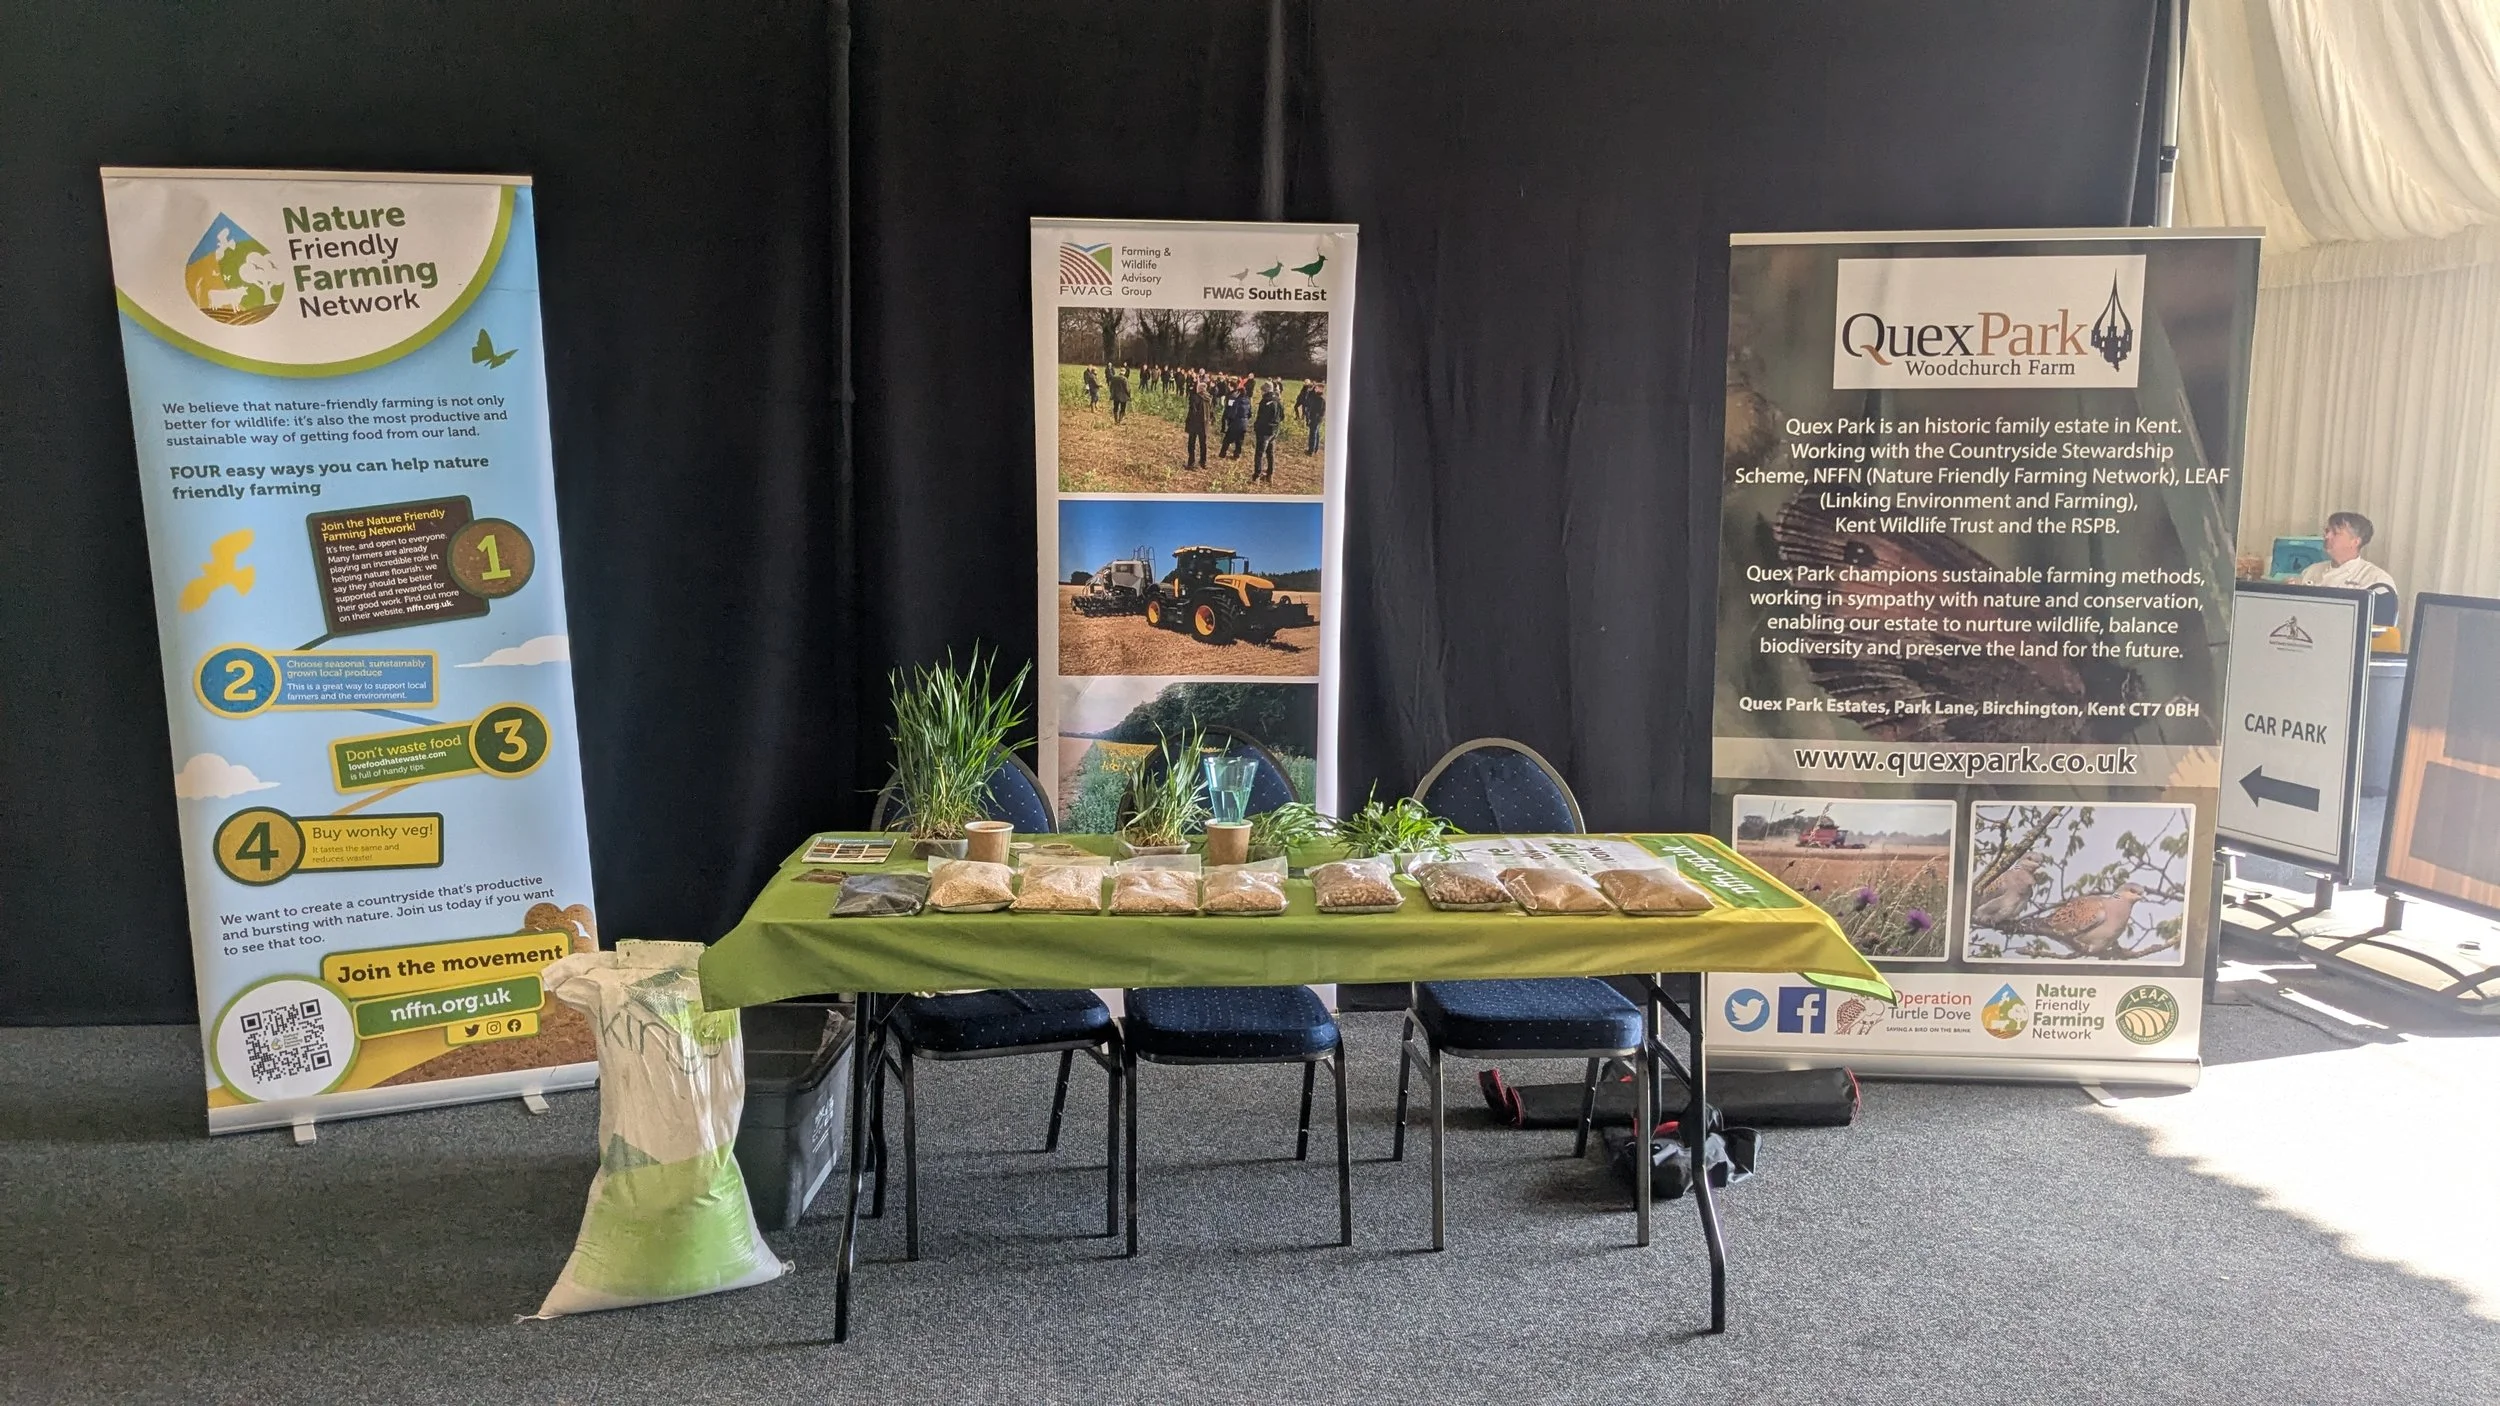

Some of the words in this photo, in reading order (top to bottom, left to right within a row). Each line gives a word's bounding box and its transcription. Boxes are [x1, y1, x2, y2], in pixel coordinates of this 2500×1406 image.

[283, 206, 406, 234] Nature
[289, 233, 398, 260] Friendly
[1122, 246, 1160, 258] Farming
[1164, 248, 1171, 256] &
[1121, 260, 1156, 269] Wildlife
[294, 260, 438, 292] Farming
[1122, 273, 1162, 285] Advisory
[1060, 286, 1112, 296] FWAG
[1122, 286, 1152, 298] Group
[1204, 287, 1244, 299] FWAG
[300, 288, 420, 318] Network
[1905, 359, 2021, 376] Woodchurch
[2028, 360, 2075, 375] Farm
[162, 403, 184, 414] We
[188, 402, 239, 413] believe
[243, 401, 271, 411] that
[274, 398, 378, 411] nature-friendly
[382, 397, 434, 409] farming
[438, 397, 448, 406] is
[451, 397, 473, 406] not
[477, 395, 504, 407] only
[1786, 418, 1833, 436] Quex
[1838, 418, 1875, 434] Park
[1880, 418, 1892, 434] is
[1898, 422, 1919, 434] an
[1926, 417, 1990, 433] historic
[1995, 417, 2050, 437] family
[2055, 419, 2109, 433] estate
[2115, 418, 2130, 433] in
[2136, 417, 2181, 433] Kent.
[1791, 442, 1865, 462] Working
[1870, 442, 1909, 458] with
[1915, 442, 1944, 458] the
[1949, 442, 2057, 462] Countryside
[2062, 442, 2173, 462] Stewardship
[170, 465, 221, 479] FOUR
[226, 466, 265, 479] easy
[270, 465, 314, 477] ways
[318, 463, 352, 476] you
[356, 462, 388, 472] can
[391, 458, 429, 472] help
[434, 457, 488, 469] nature
[1735, 467, 1808, 486] Scheme,
[1814, 468, 1861, 483] NFFN
[1867, 468, 1933, 486] (Nature
[1939, 467, 2010, 488] Friendly
[2015, 468, 2086, 487] Farming
[2093, 467, 2179, 486] Network),
[2186, 468, 2230, 484] LEAF
[172, 484, 245, 500] friendly
[250, 482, 320, 496] farming
[1820, 492, 1891, 512] (Linking
[1897, 492, 2011, 508] Environment
[2016, 492, 2049, 508] and
[2055, 493, 2137, 512] Farming),
[321, 522, 344, 531] Join
[346, 520, 364, 528] the
[366, 516, 402, 526] Nature
[404, 509, 445, 524] Friendly
[1836, 517, 1876, 532] Kent
[1880, 516, 1946, 533] Wildlife
[1950, 518, 1994, 533] Trust
[1999, 517, 2032, 533] and
[2037, 517, 2066, 533] the
[2072, 518, 2119, 533] RSPB.
[322, 530, 366, 542] Farming
[369, 522, 416, 536] Network!
[476, 535, 511, 580] 1
[1747, 566, 1793, 585] Quex
[1796, 566, 1835, 581] Park
[1839, 566, 1937, 586] champions
[1942, 566, 2042, 582] sustainable
[2047, 566, 2116, 587] farming
[2122, 568, 2204, 586] methods,
[1750, 590, 1821, 609] working
[1828, 591, 1842, 605] in
[1848, 591, 1934, 610] sympathy
[1940, 591, 1977, 606] with
[1984, 594, 2040, 607] nature
[2046, 592, 2078, 607] and
[2084, 594, 2202, 611] conservation,
[1768, 614, 1847, 634] enabling
[1850, 619, 1880, 630] our
[1884, 617, 1938, 631] estate
[1943, 618, 1960, 631] to
[1966, 618, 2032, 632] nurture
[2037, 616, 2103, 634] wildlife,
[2110, 617, 2178, 633] balance
[1760, 637, 1863, 660] biodiversity
[1866, 638, 1902, 658] and
[1906, 640, 1981, 659] preserve
[1986, 640, 2015, 656] the
[2020, 640, 2058, 656] land
[2063, 641, 2087, 656] for
[2092, 641, 2120, 657] the
[2125, 641, 2183, 658] future.
[224, 660, 256, 700] 2
[1740, 697, 1782, 711] Quex
[1786, 698, 1823, 712] Park
[1827, 696, 1890, 715] Estates,
[1894, 697, 1934, 717] Park
[1935, 701, 1978, 716] Lane,
[1983, 700, 2083, 718] Birchington,
[2088, 702, 2126, 716] Kent
[2129, 703, 2161, 716] CT7
[2165, 703, 2199, 716] 0BH
[2245, 714, 2276, 736] CAR
[2282, 719, 2327, 744] PARK
[346, 747, 383, 761] Don't
[387, 742, 426, 755] waste
[430, 735, 462, 749] food
[494, 718, 527, 762] 3
[348, 751, 447, 771] lovefoodhatewaste.com
[1794, 746, 2138, 778] www.quexpark.co.uk
[373, 769, 381, 777] of
[383, 766, 408, 775] handy
[312, 827, 342, 841] Buy
[346, 825, 398, 839] wonky
[402, 824, 432, 838] veg!
[235, 821, 280, 872] 4
[338, 964, 391, 983] Join
[397, 960, 435, 976] the
[442, 945, 563, 971] movement
[2036, 984, 2096, 1001] Nature
[2130, 988, 2169, 1003] LEAF
[391, 988, 511, 1021] nffn.org.uk
[1888, 1006, 1928, 1019] Turtle
[1934, 1007, 1971, 1020] Dove
[2034, 999, 2090, 1015] Friendly
[2033, 1012, 2104, 1032] Farming
[2032, 1028, 2091, 1039] Network
